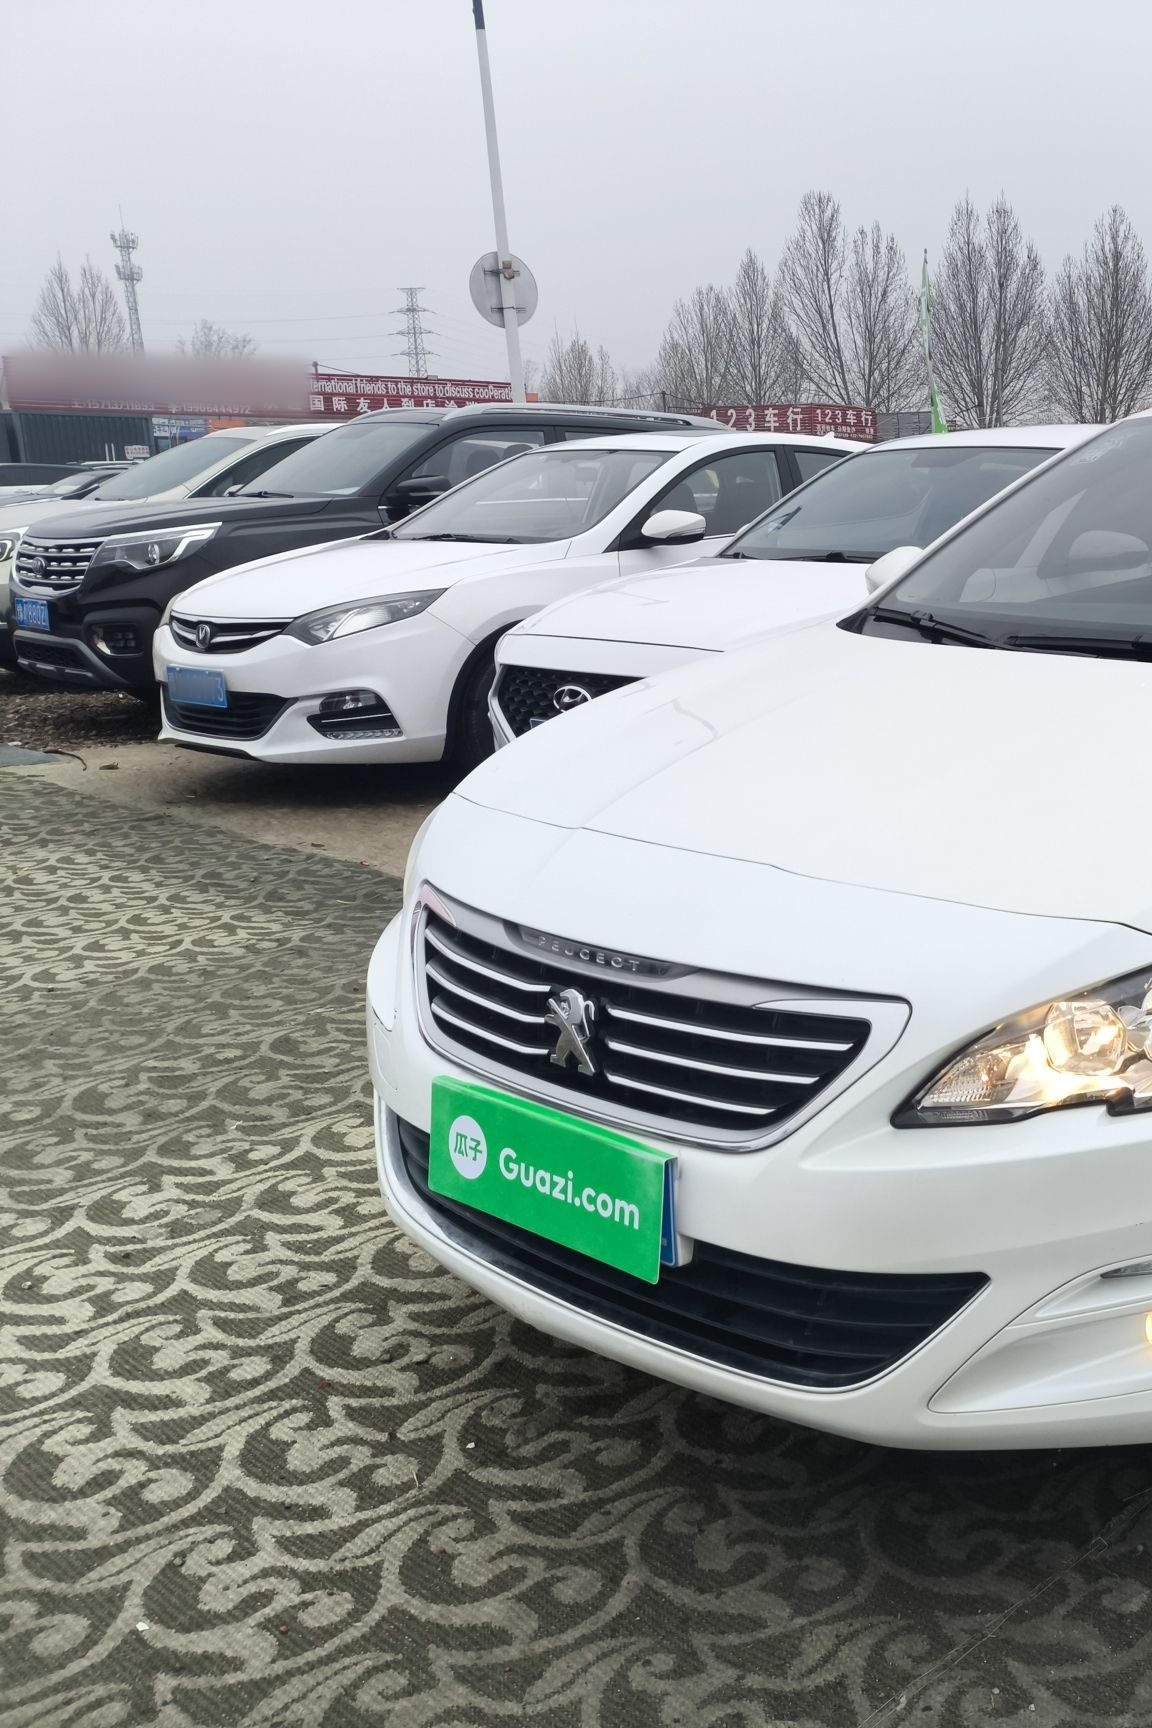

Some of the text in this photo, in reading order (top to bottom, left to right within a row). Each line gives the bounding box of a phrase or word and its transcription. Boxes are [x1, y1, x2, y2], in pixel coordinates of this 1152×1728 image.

[357, 378, 386, 394] friends
[388, 381, 397, 394] to
[399, 380, 411, 395] the
[413, 383, 433, 396] store
[435, 384, 444, 397] to
[445, 383, 473, 398] discuss
[710, 407, 802, 431] 123车行
[815, 409, 873, 426] 123车行
[537, 935, 641, 971] PEUGEOT
[454, 1132, 483, 1162] 瓜子
[499, 1147, 640, 1230] Guazi.com
